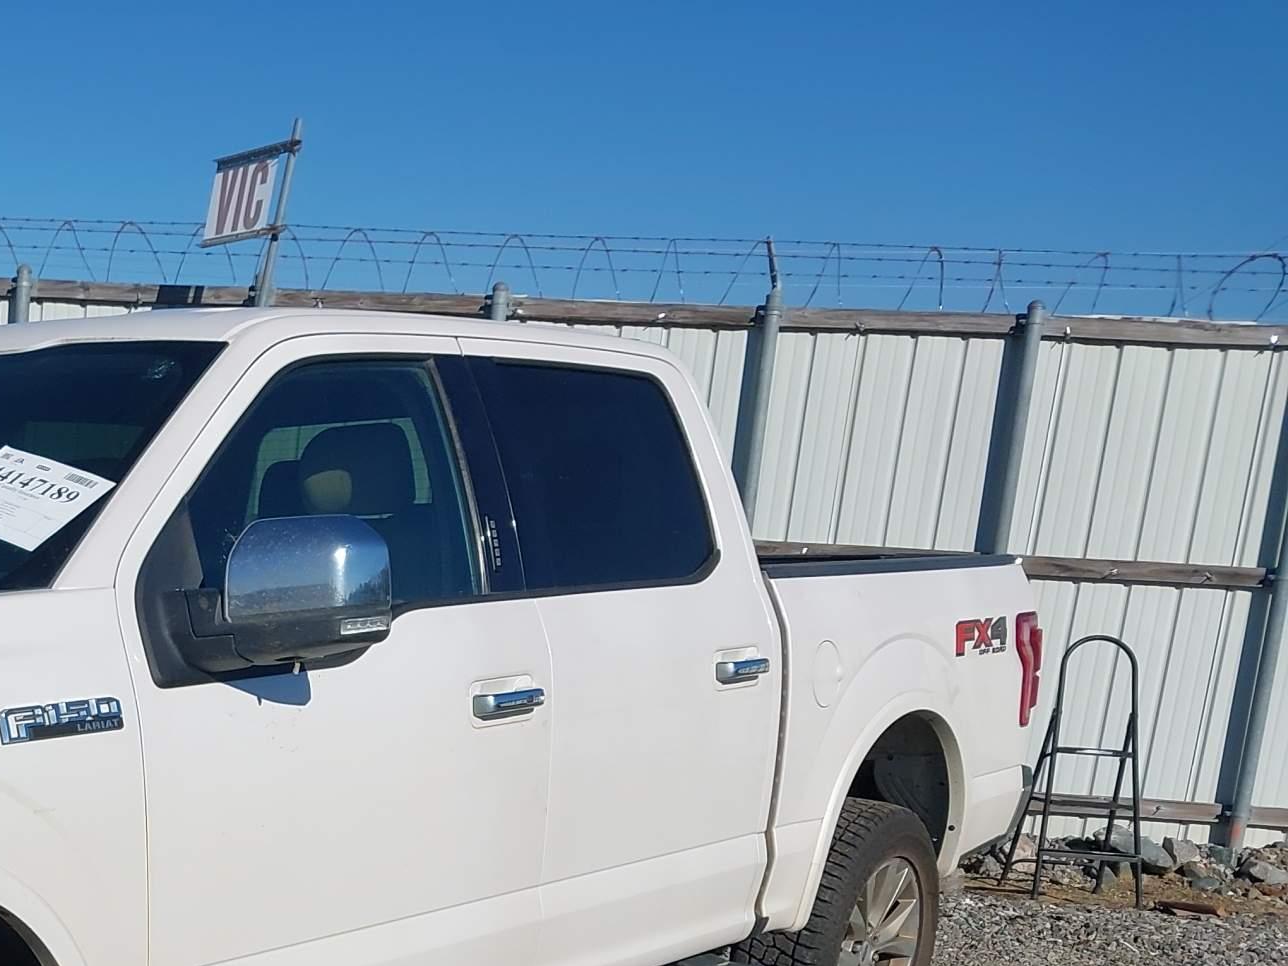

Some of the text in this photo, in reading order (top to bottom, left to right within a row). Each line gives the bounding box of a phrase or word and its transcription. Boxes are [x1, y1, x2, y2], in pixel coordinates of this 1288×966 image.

[215, 160, 269, 235] VIC
[955, 615, 1008, 657] FX4
[77, 718, 120, 732] LARIAT
